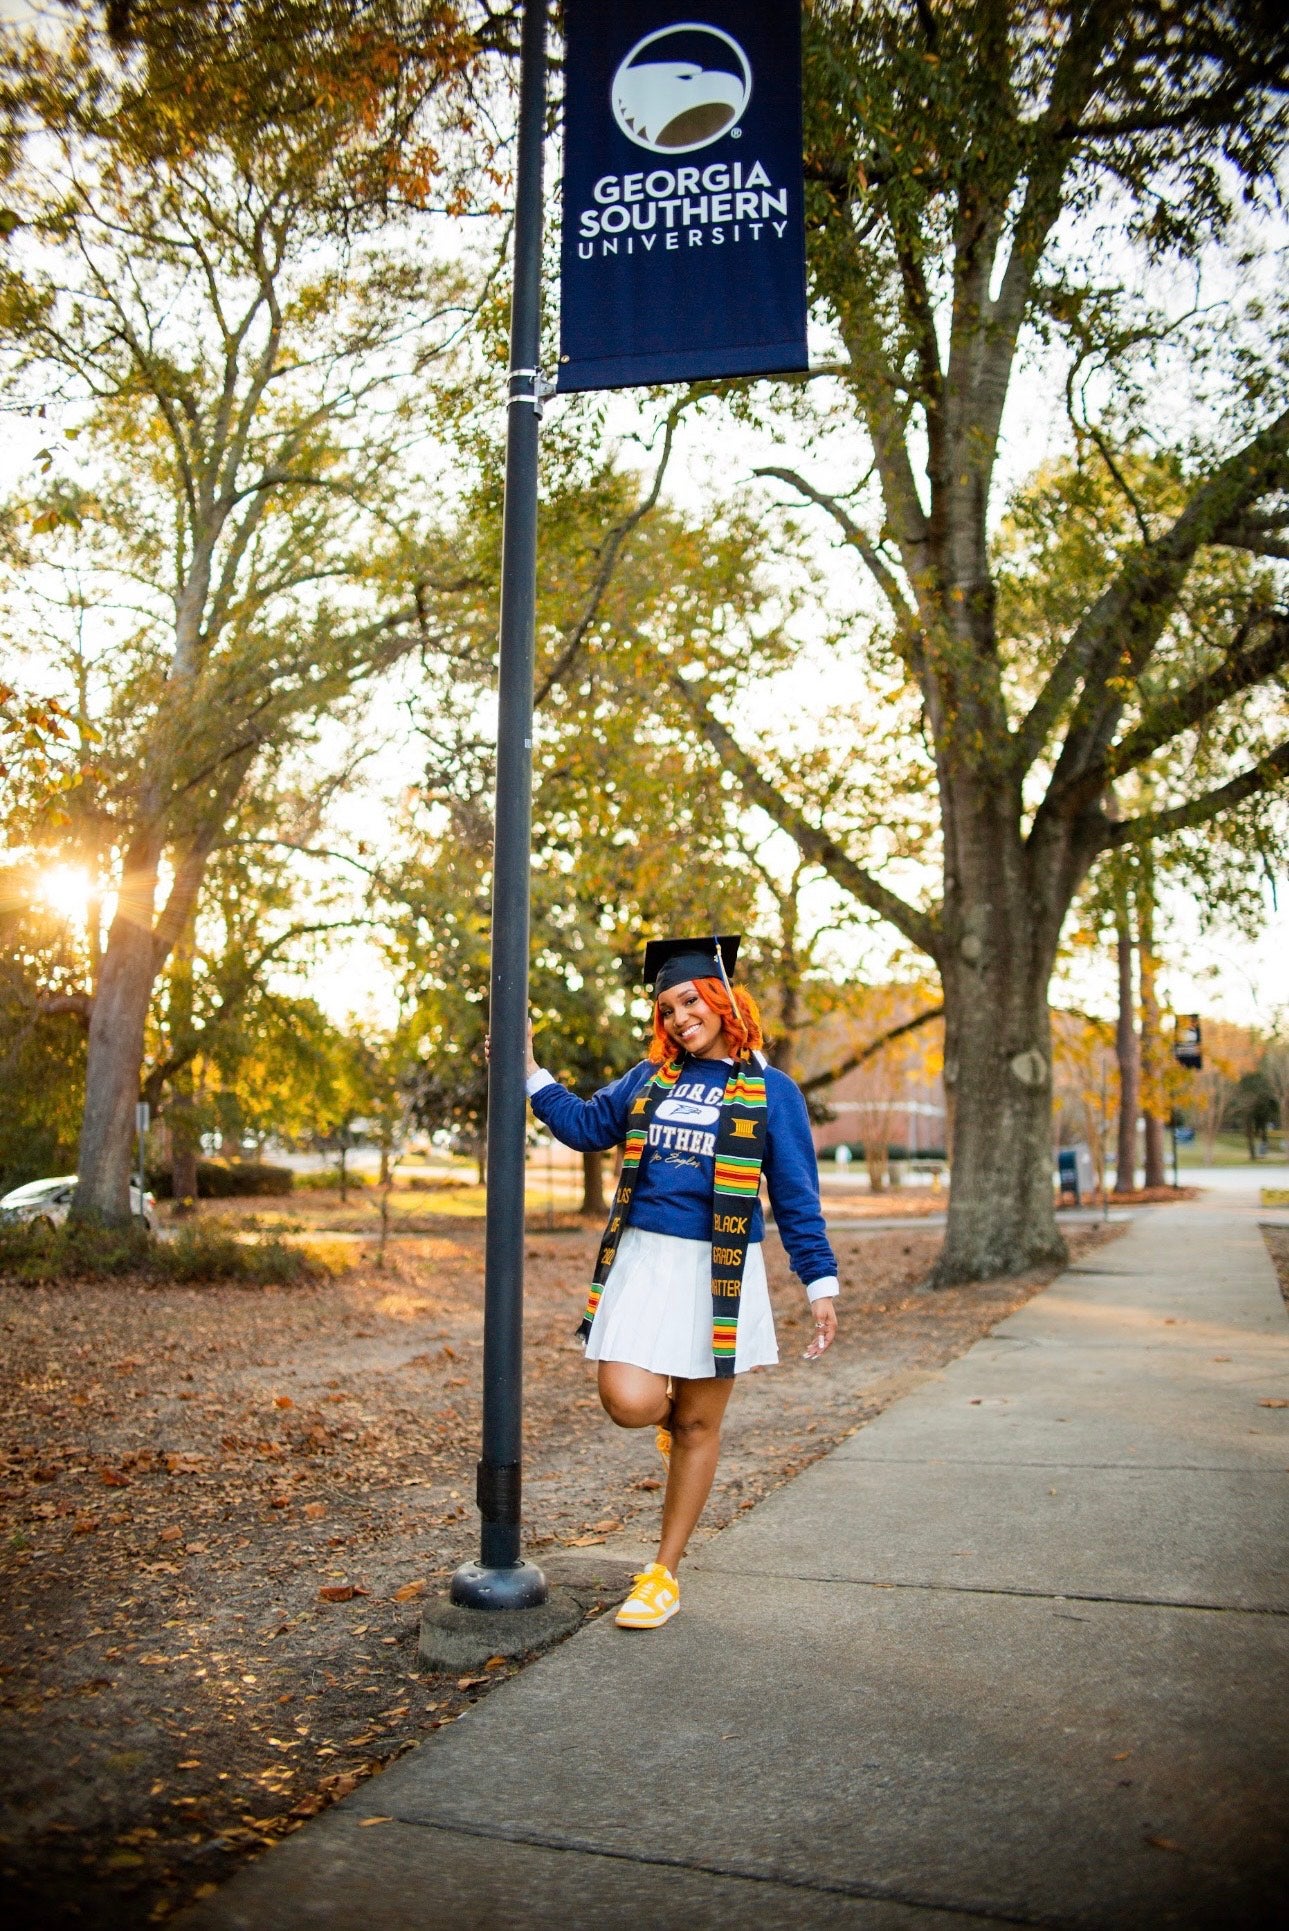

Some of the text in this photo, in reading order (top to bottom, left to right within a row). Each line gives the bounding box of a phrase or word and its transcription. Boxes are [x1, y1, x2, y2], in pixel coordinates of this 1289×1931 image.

[593, 160, 772, 204] GEORGIA
[579, 188, 788, 238] SOUTHERN
[578, 220, 788, 260] UNIVERSITY
[667, 1083, 724, 1107] ORG
[714, 1213, 748, 1235] BLACK
[713, 1246, 743, 1267] GRADS
[711, 1279, 741, 1297] ATTER
